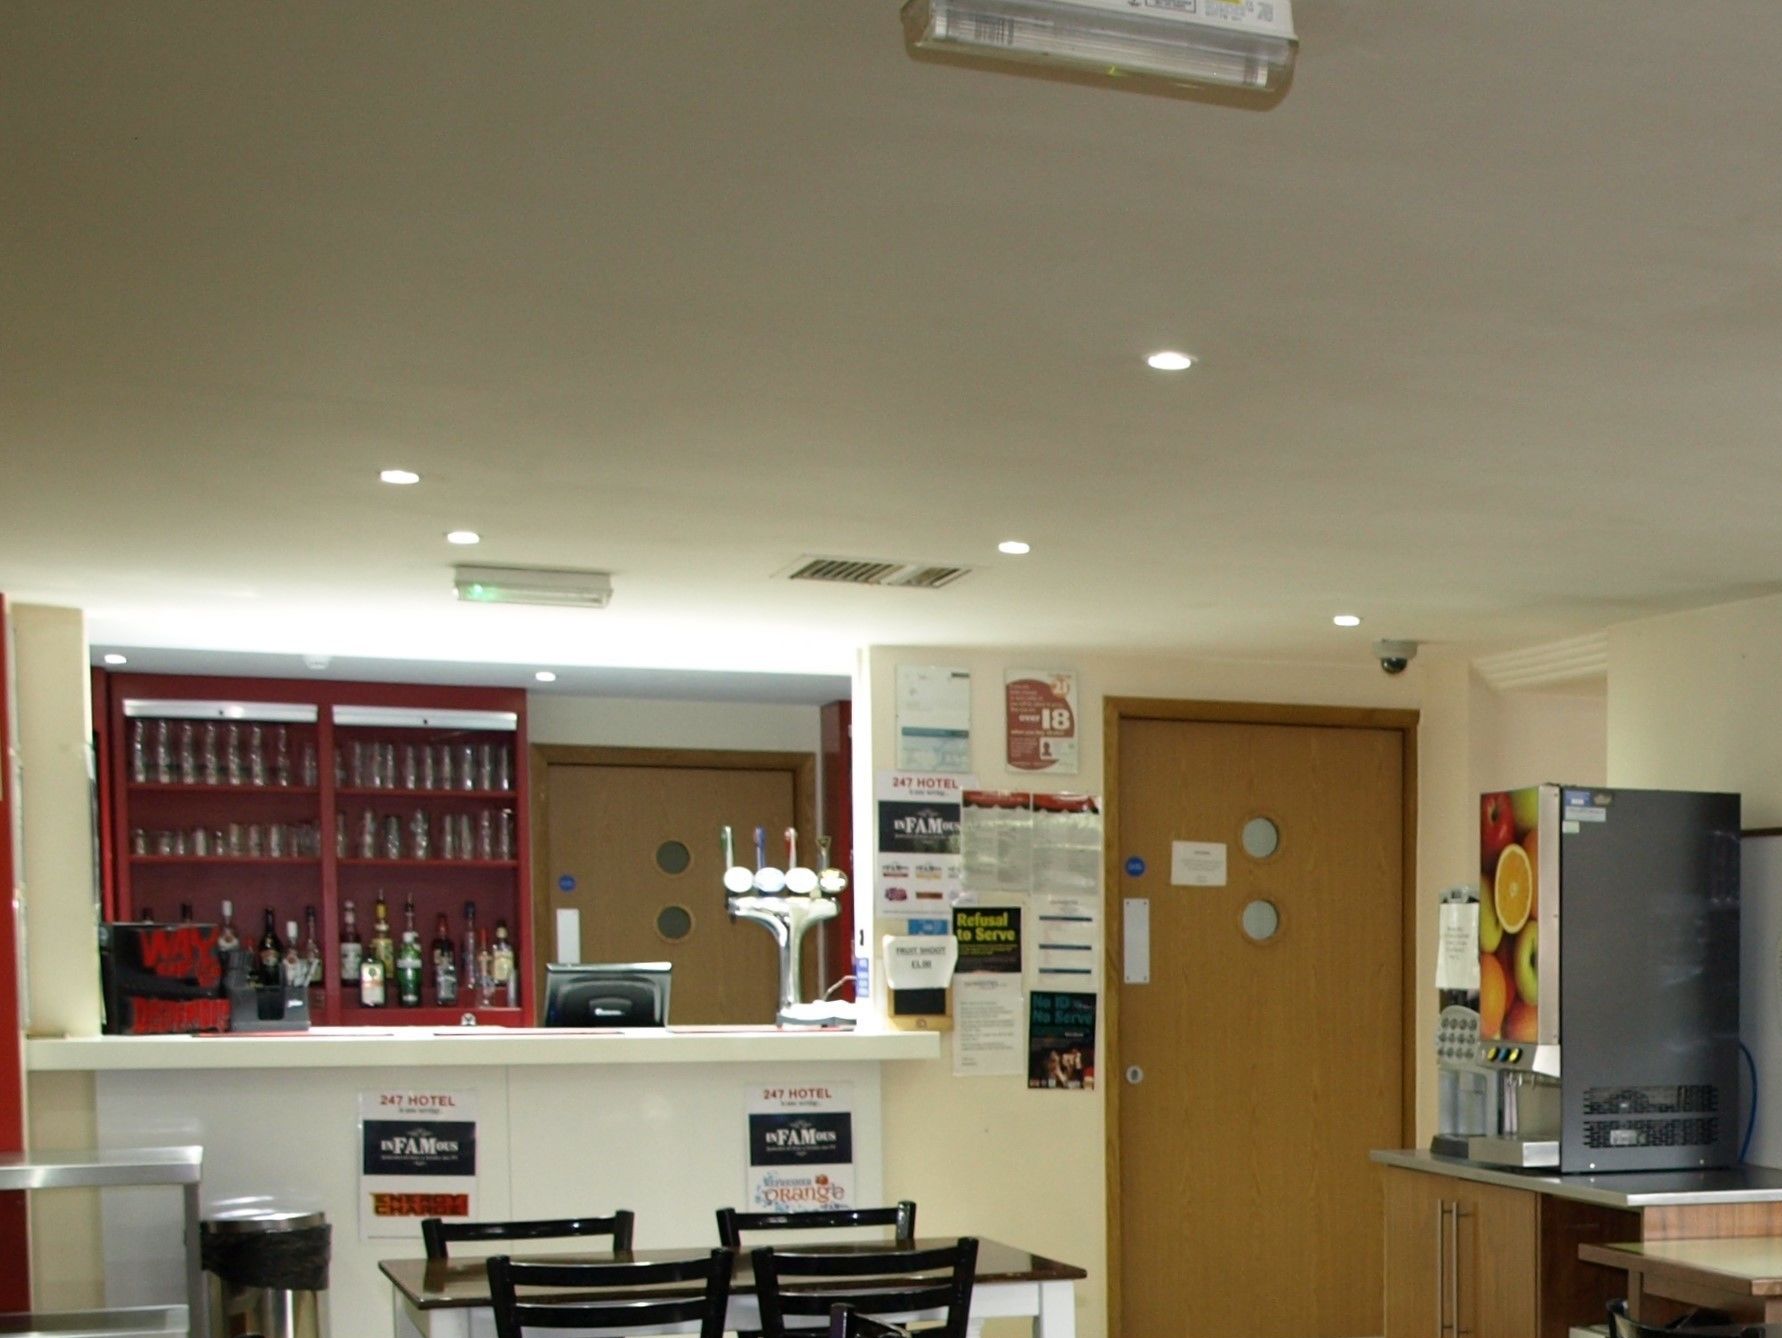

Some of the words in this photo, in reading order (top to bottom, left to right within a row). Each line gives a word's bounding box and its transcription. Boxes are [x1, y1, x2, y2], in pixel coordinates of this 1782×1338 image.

[1042, 708, 1070, 730] 18
[893, 777, 913, 788] 247
[917, 778, 958, 789] HOTEL
[957, 912, 1008, 926] Refusal
[957, 929, 972, 941] to
[975, 928, 1016, 941] Serve
[381, 1096, 402, 1106] 247
[409, 1095, 455, 1106] HOTEL
[764, 1090, 784, 1100] 247
[789, 1088, 832, 1098] HOTEL
[765, 1128, 837, 1146] INFAMOUS
[381, 1137, 458, 1154] INFAMOUS
